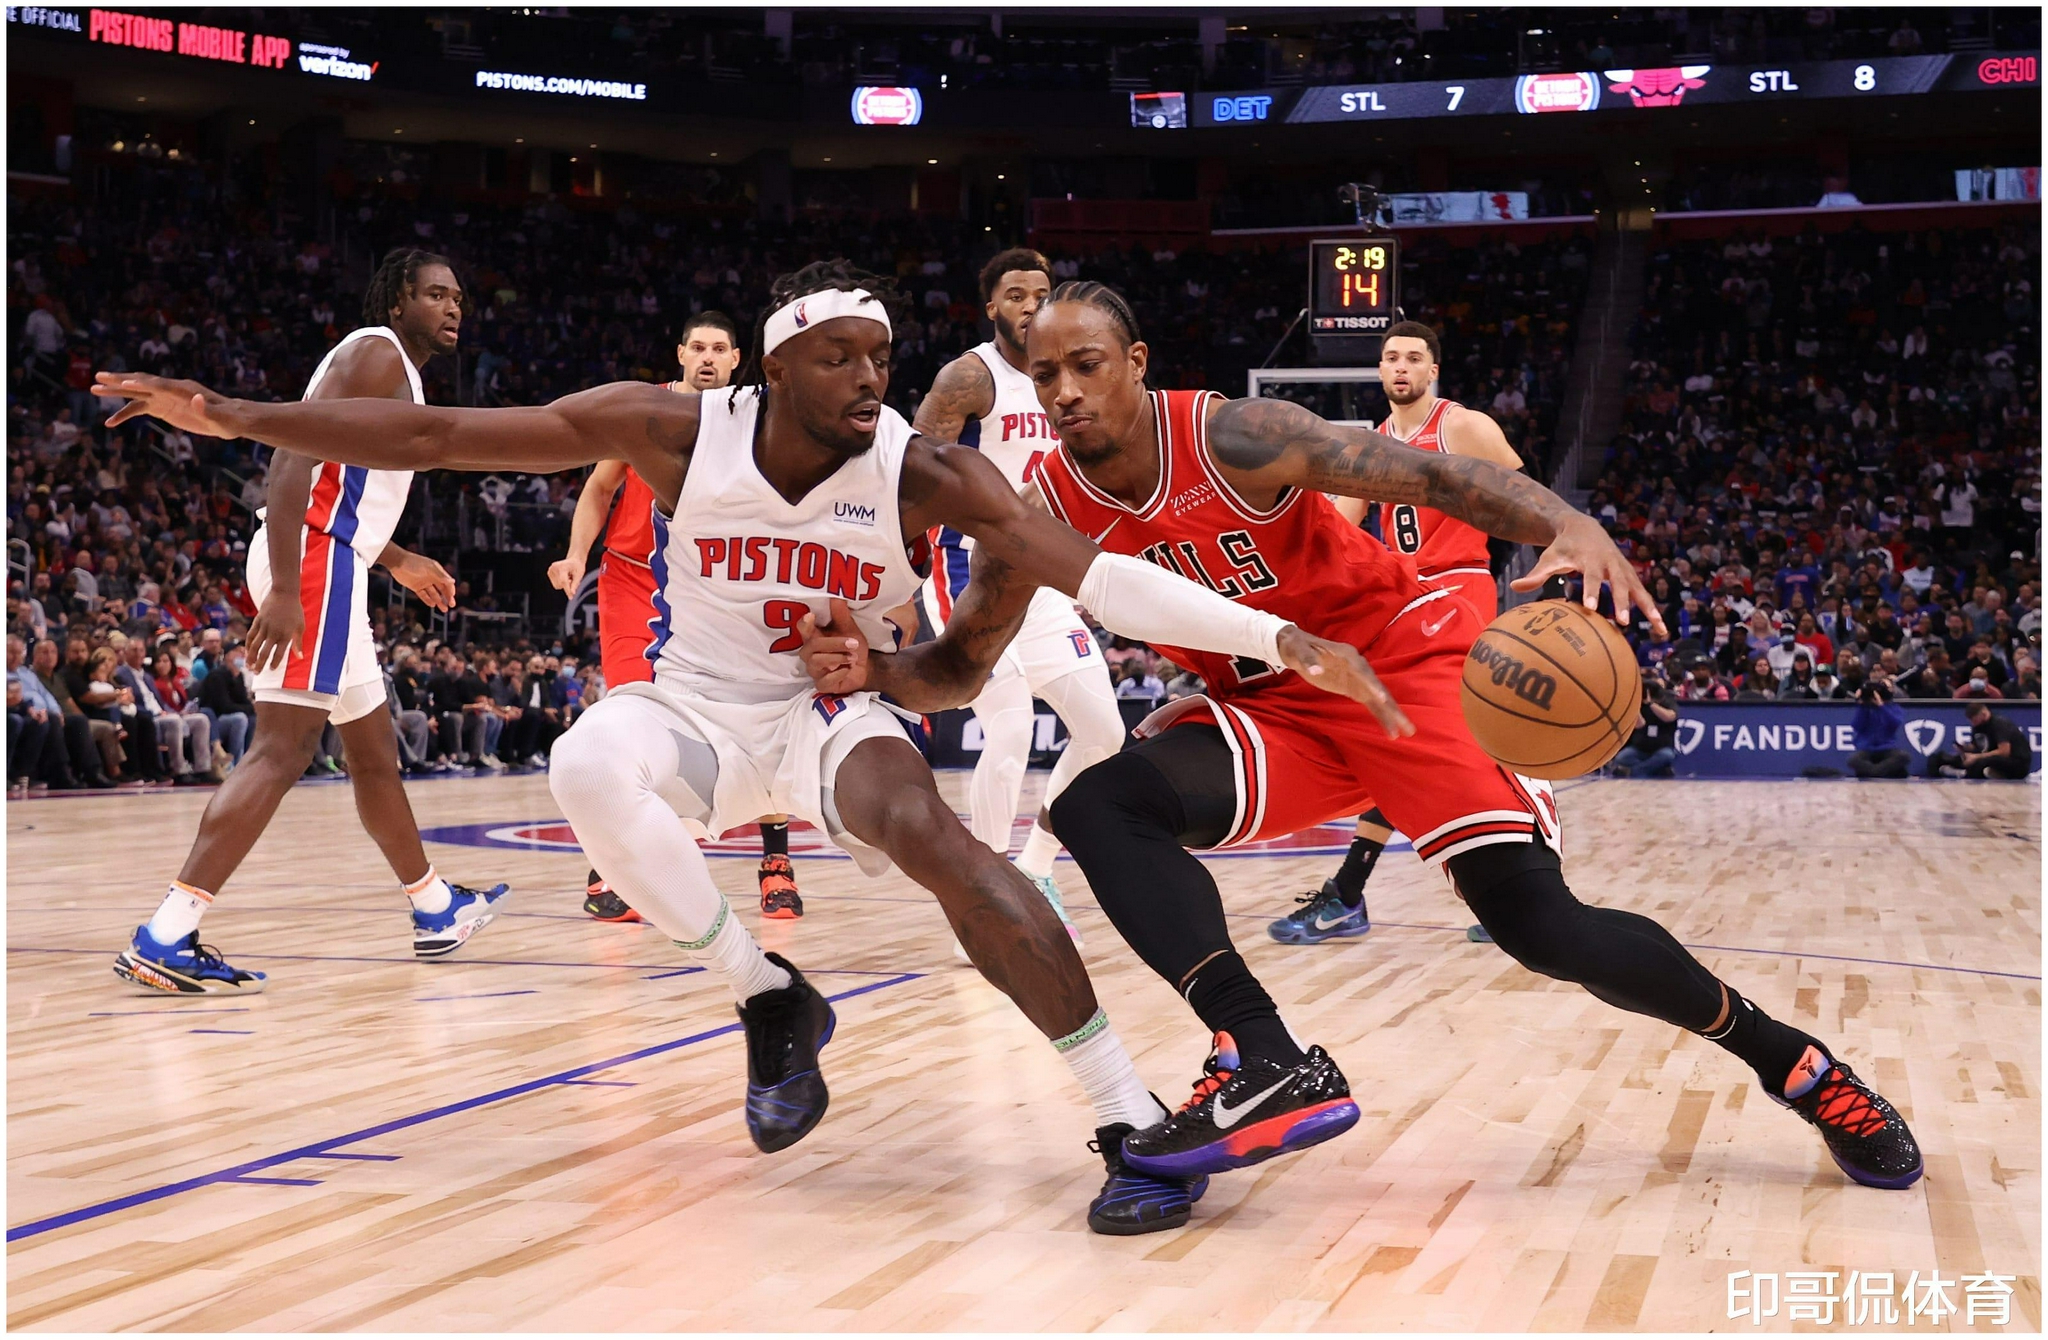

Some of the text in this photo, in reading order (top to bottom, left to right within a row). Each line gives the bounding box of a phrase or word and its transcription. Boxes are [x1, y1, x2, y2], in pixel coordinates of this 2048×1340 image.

[21, 6, 82, 32] OFFICIAL
[90, 8, 290, 69] PISTONS MOBILE APP
[299, 55, 371, 81] verizon
[1854, 65, 1876, 91] 8
[1978, 57, 2036, 84] CHI
[476, 71, 646, 100] PISTONS.COM/MOBILE
[1749, 70, 1798, 93] STL
[1213, 96, 1272, 122] DET
[1340, 91, 1386, 112] STL
[1445, 86, 1465, 111] 7
[1335, 247, 1385, 270] 2:19
[1343, 273, 1378, 307] 14
[1334, 317, 1389, 328] TISSOT
[834, 501, 875, 521] UWM
[1392, 504, 1422, 556] 8
[694, 536, 886, 601] PISTONS
[764, 599, 811, 654] 9
[1468, 638, 1557, 711] Wilson
